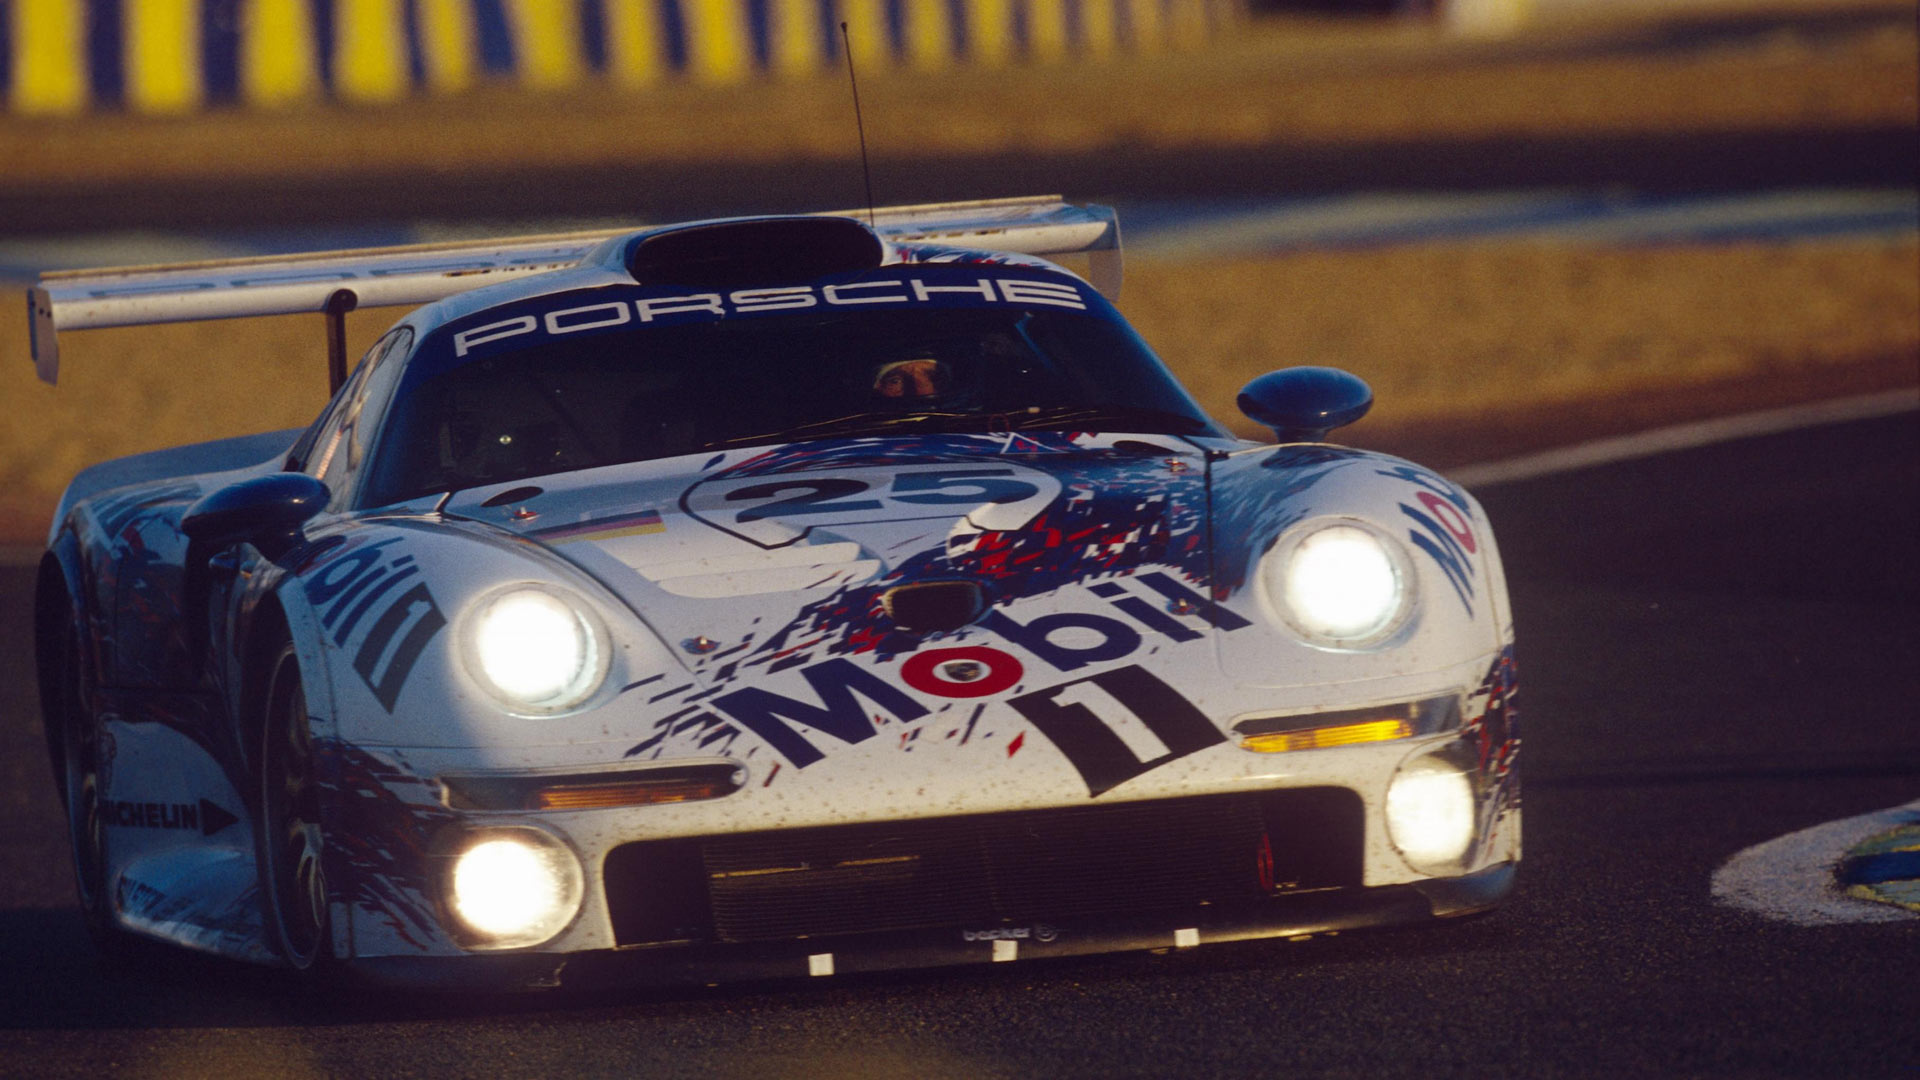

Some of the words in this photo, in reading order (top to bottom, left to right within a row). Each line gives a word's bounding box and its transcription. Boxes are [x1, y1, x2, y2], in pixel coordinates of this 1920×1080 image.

[454, 279, 1086, 357] PORSCHE
[725, 469, 1038, 523] 25
[1374, 462, 1477, 620] Mob
[712, 572, 1253, 769] Mobil
[1048, 680, 1172, 763] 1
